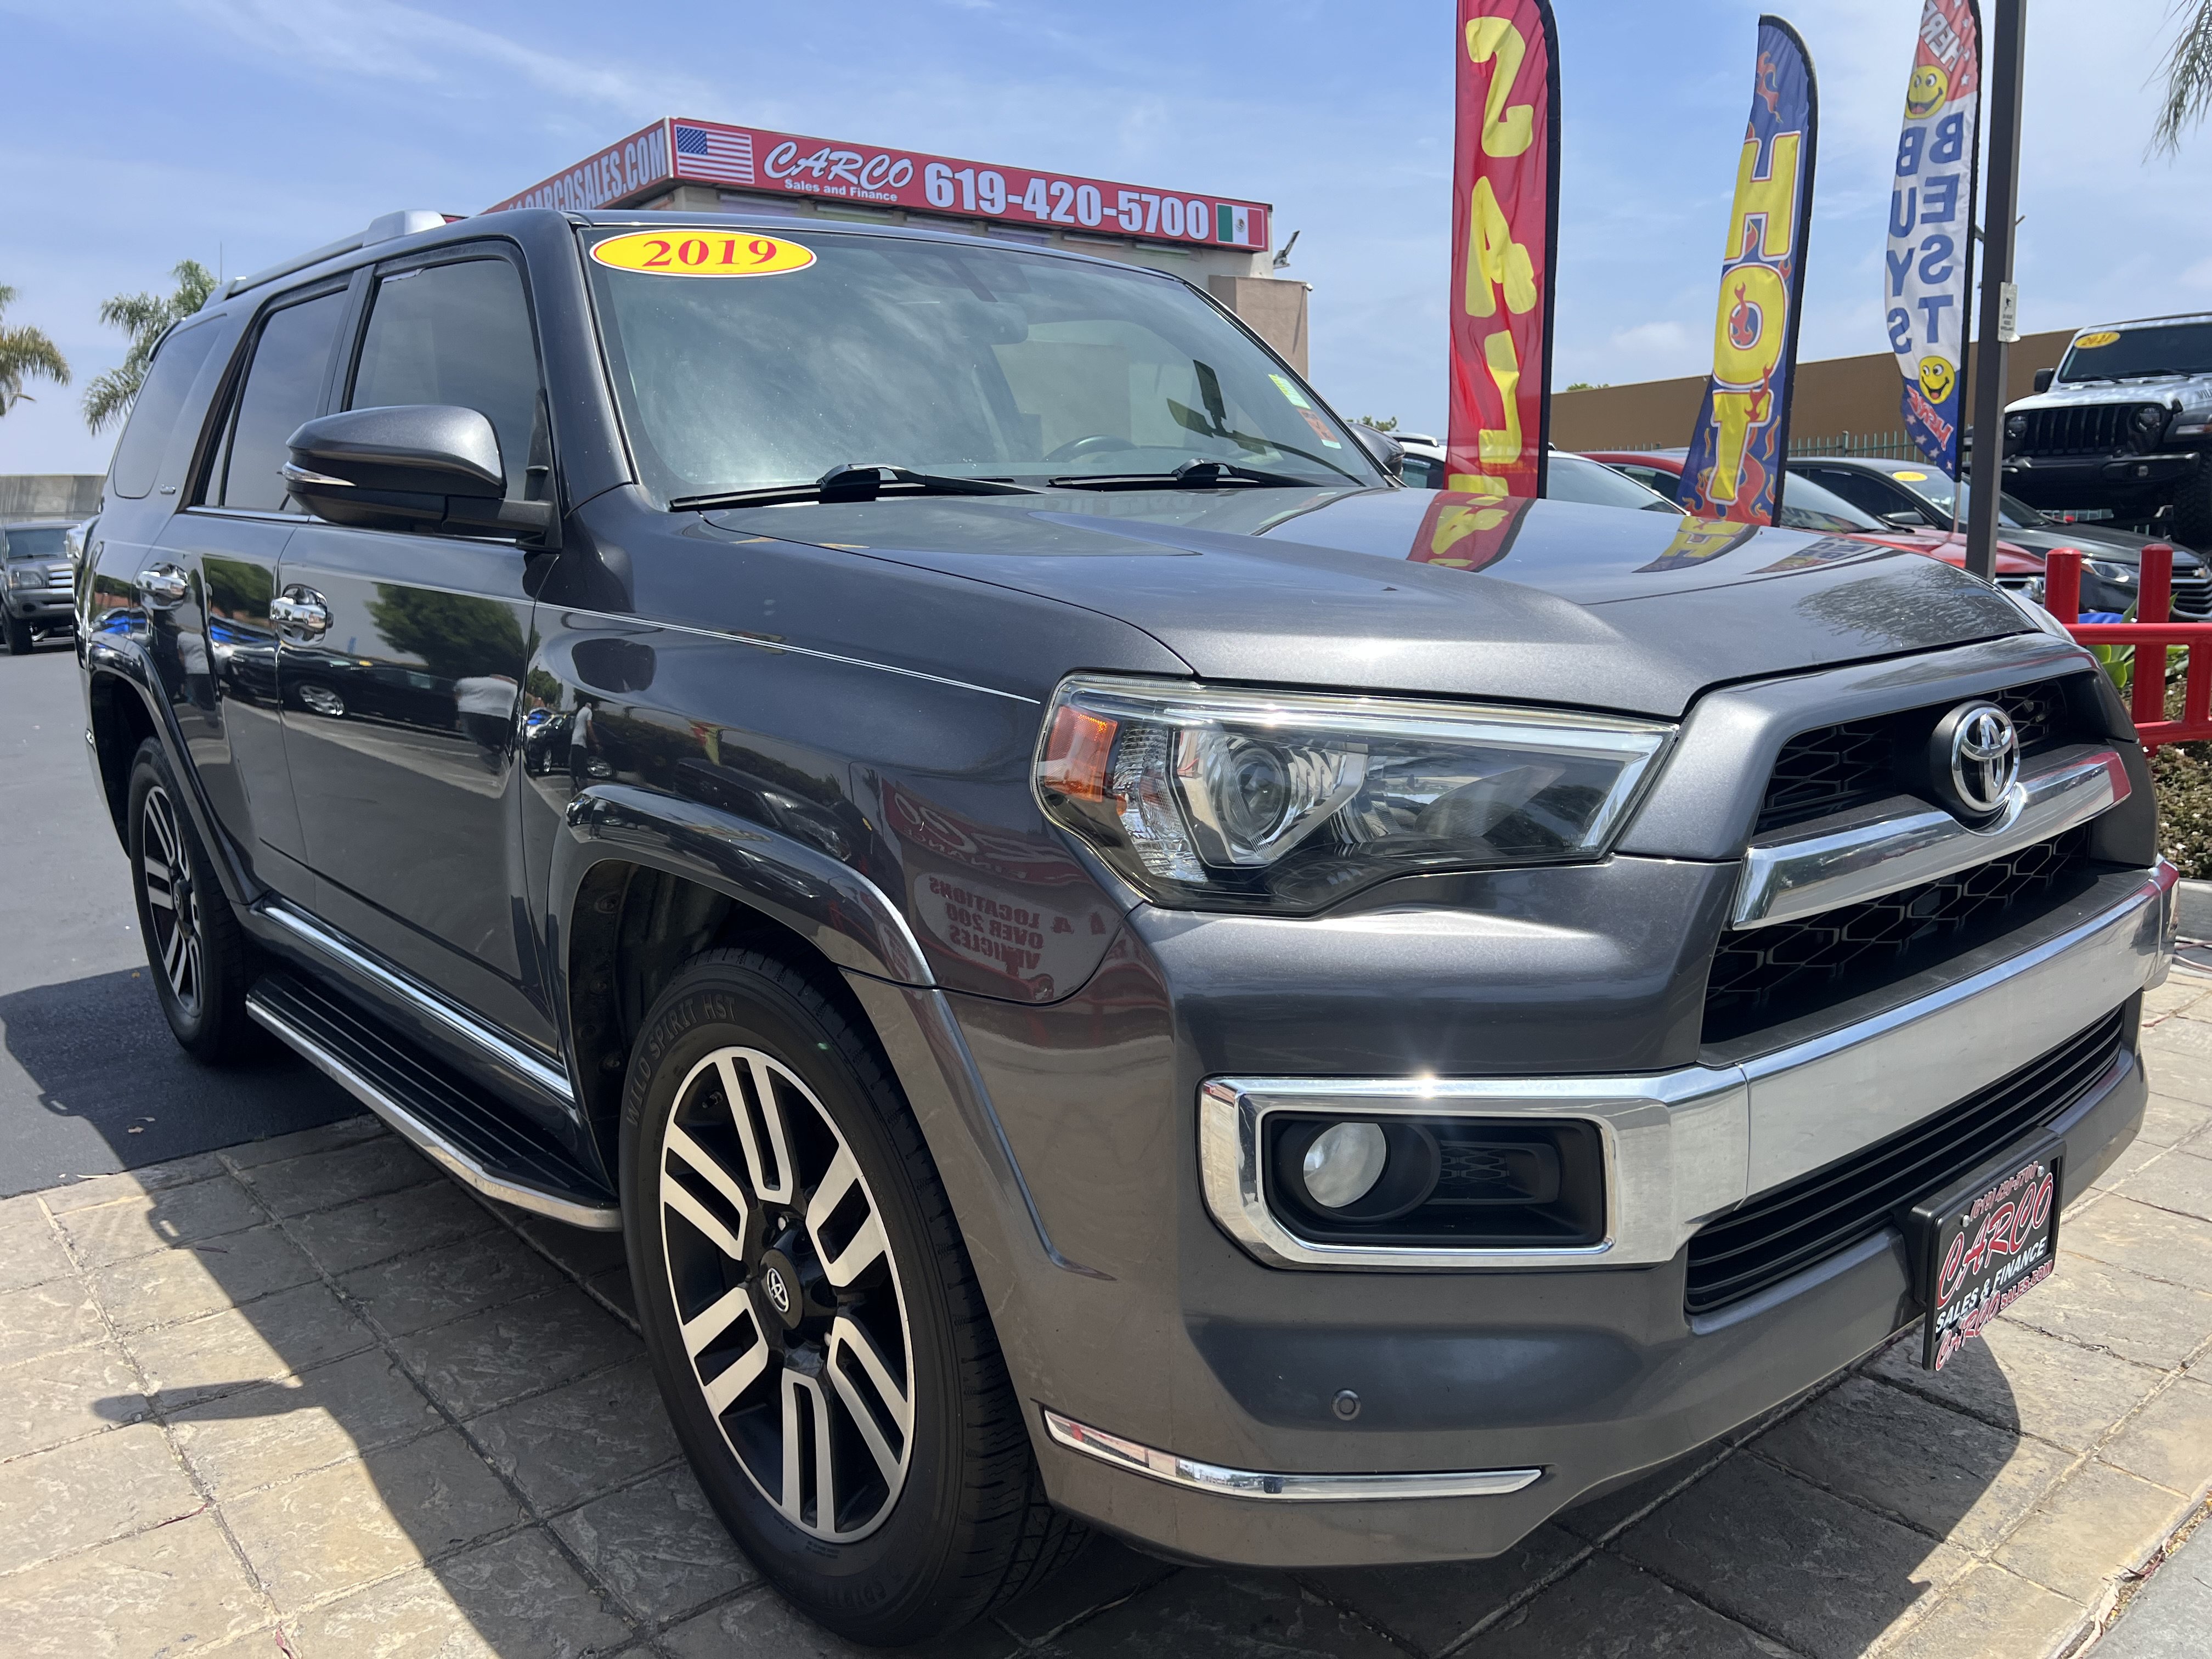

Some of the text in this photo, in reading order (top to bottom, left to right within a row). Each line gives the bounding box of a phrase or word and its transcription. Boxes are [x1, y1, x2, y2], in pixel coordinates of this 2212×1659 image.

[763, 140, 914, 190] CARCO
[785, 179, 898, 201] Sales and Finance
[924, 162, 1209, 240] 619-420-5700
[642, 239, 777, 267] 2019
[1707, 131, 1802, 505] HOT
[649, 996, 697, 1059] SPIRIT
[1937, 1172, 2053, 1310] CARCO
[1936, 1235, 2047, 1334] SALES & FINANCE
